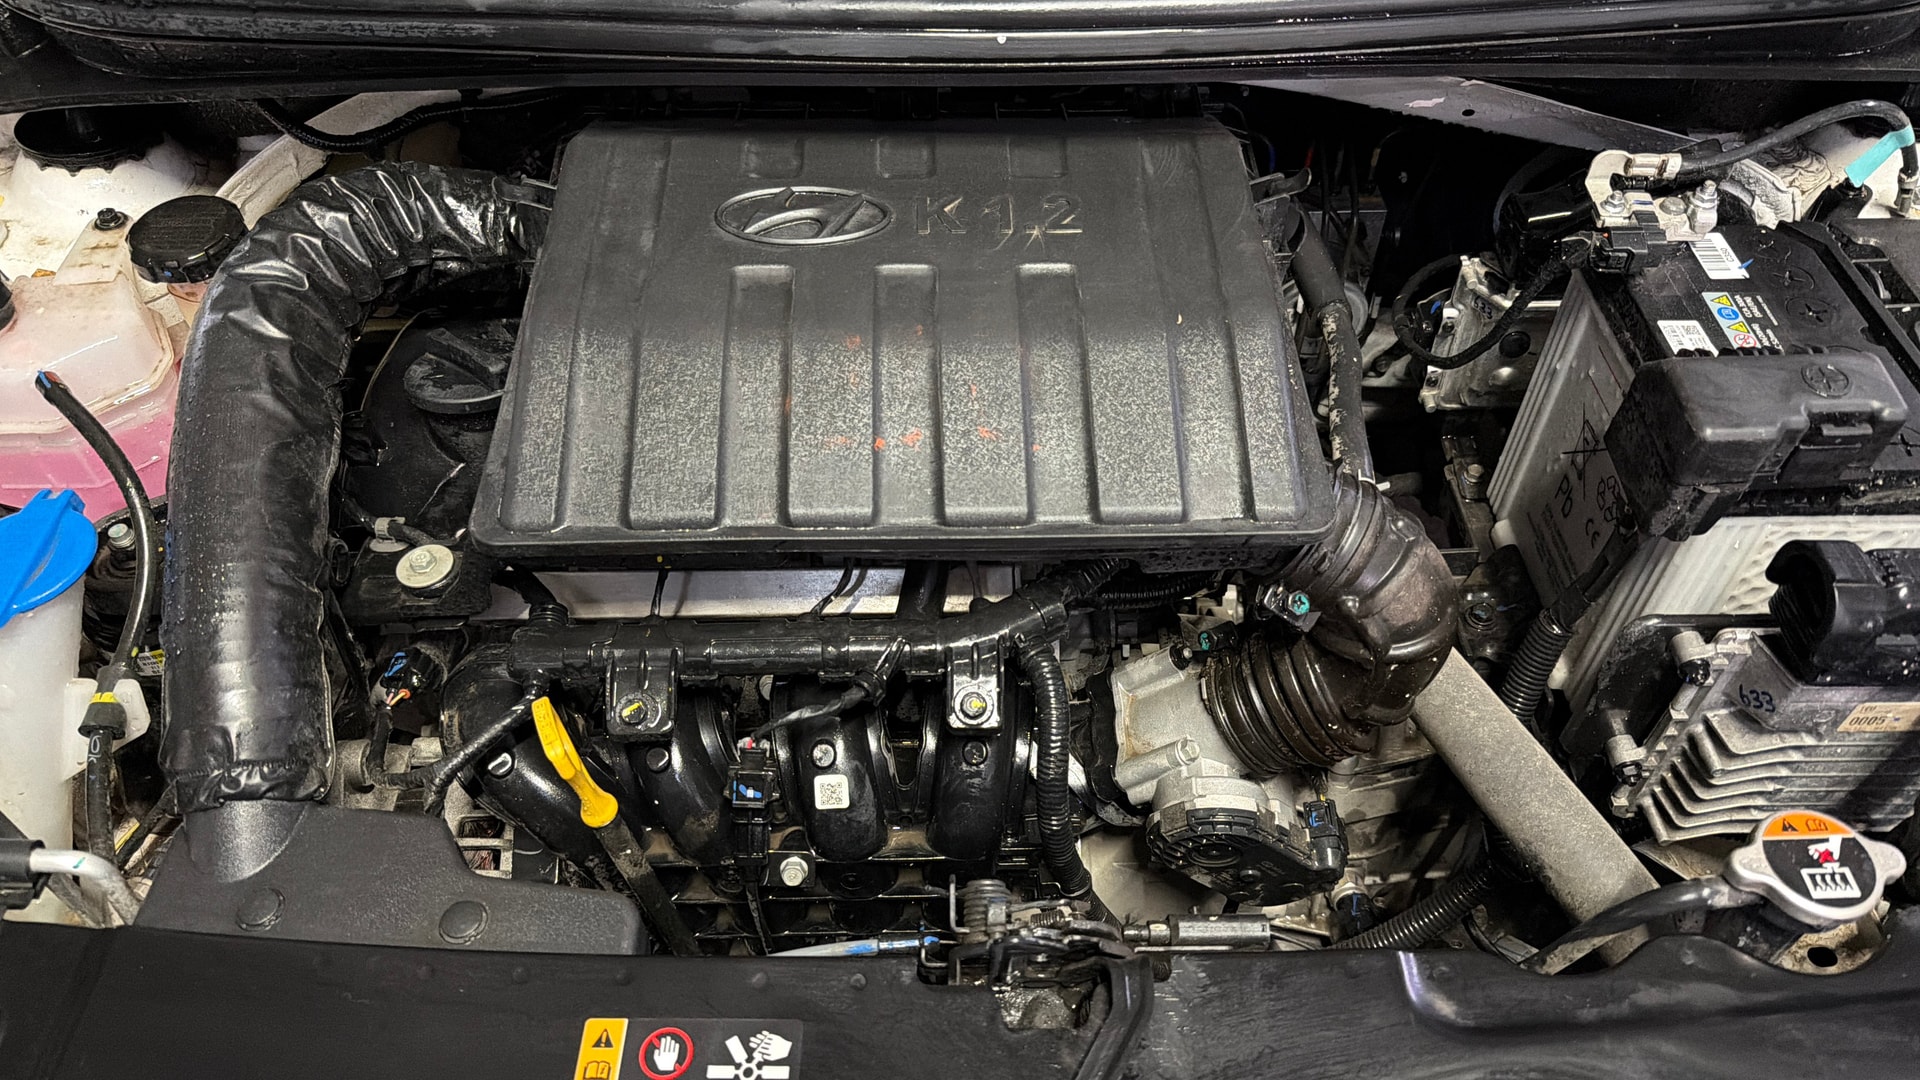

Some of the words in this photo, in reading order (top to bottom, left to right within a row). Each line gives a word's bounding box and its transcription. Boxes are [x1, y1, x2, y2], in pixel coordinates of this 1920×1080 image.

[1554, 473, 1574, 518] Pb
[1738, 684, 1776, 713] 633
[1849, 716, 1887, 726] 0005
